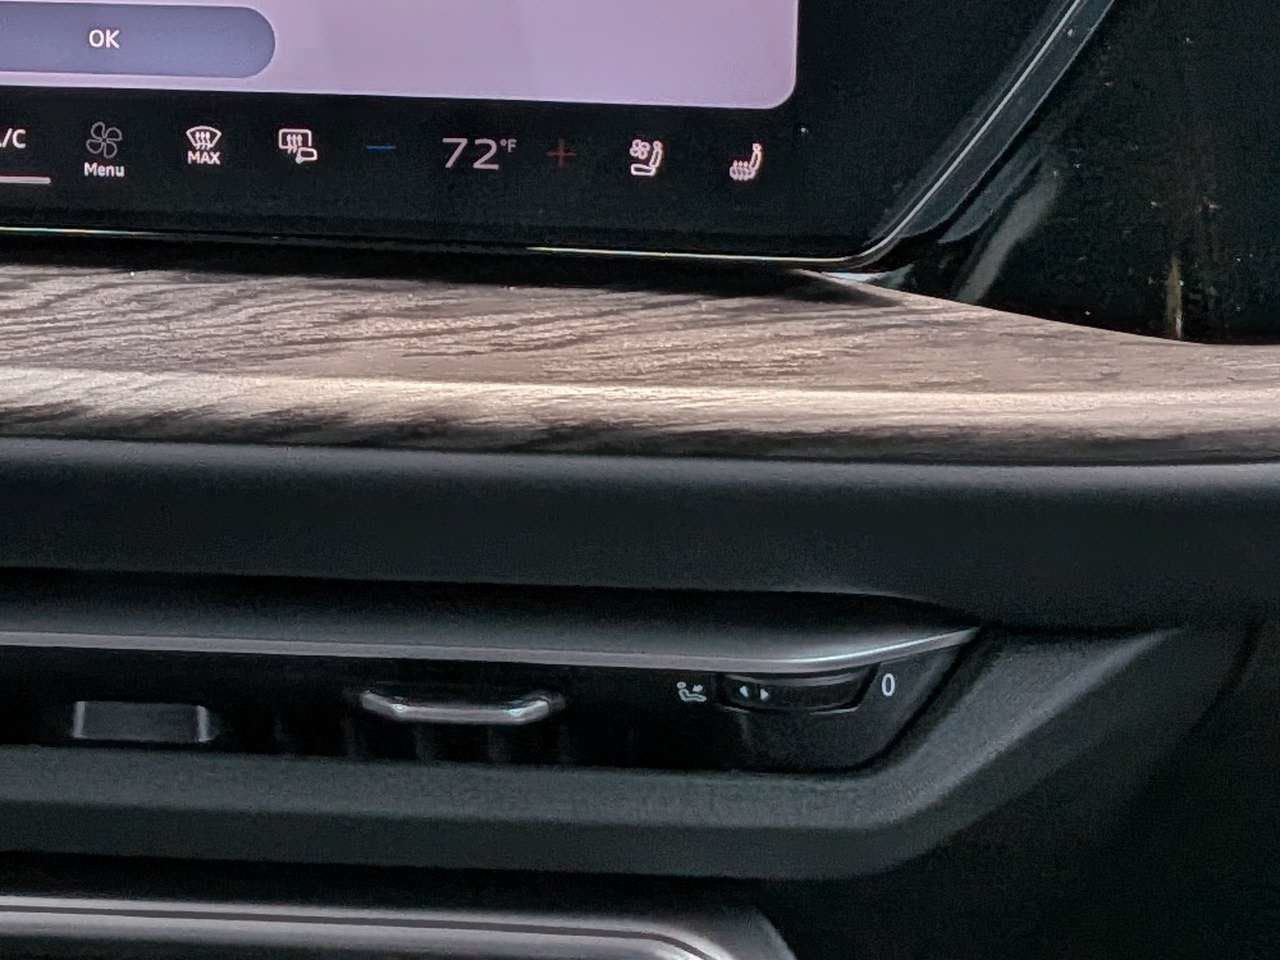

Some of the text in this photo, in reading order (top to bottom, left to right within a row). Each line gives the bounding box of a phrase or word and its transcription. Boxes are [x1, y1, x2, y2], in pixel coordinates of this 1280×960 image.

[88, 29, 120, 49] OK
[187, 150, 221, 165] MAX
[83, 161, 125, 178] Menu
[881, 672, 896, 697] 0
